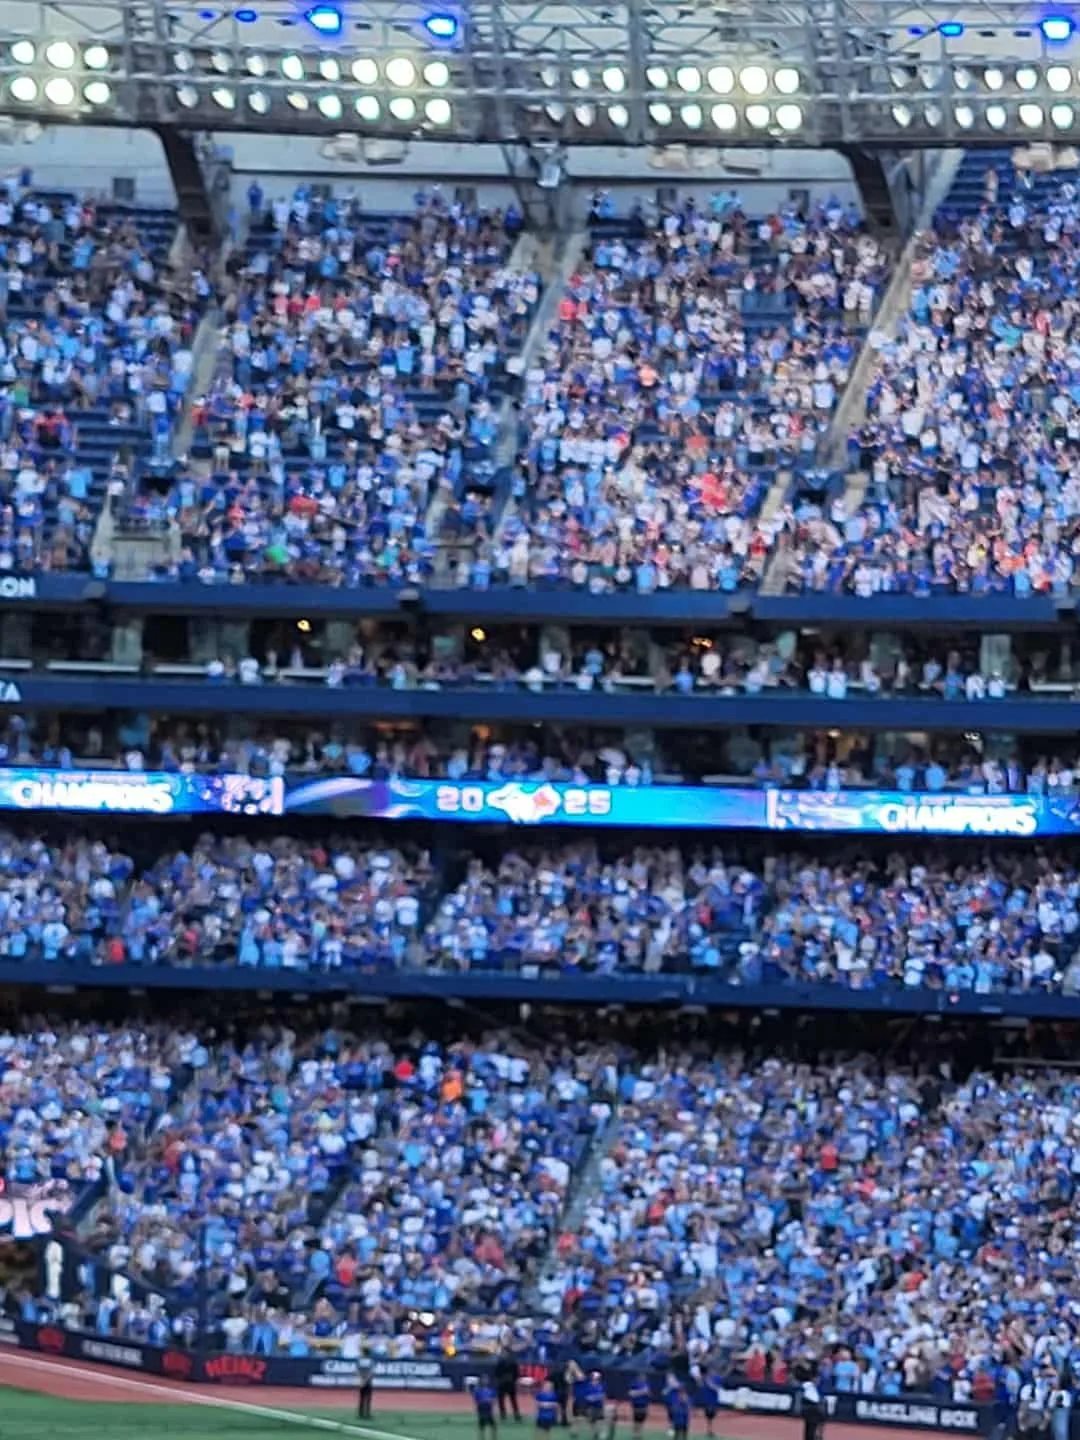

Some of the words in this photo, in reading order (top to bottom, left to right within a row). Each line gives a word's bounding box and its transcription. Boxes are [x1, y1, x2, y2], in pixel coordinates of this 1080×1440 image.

[12, 779, 174, 813] CHAMPIONS
[437, 785, 484, 811] 20
[564, 789, 611, 815] 25
[878, 803, 1037, 834] CHAMPIONS
[856, 1400, 937, 1425] BASELINE
[940, 1408, 977, 1429] BOX
